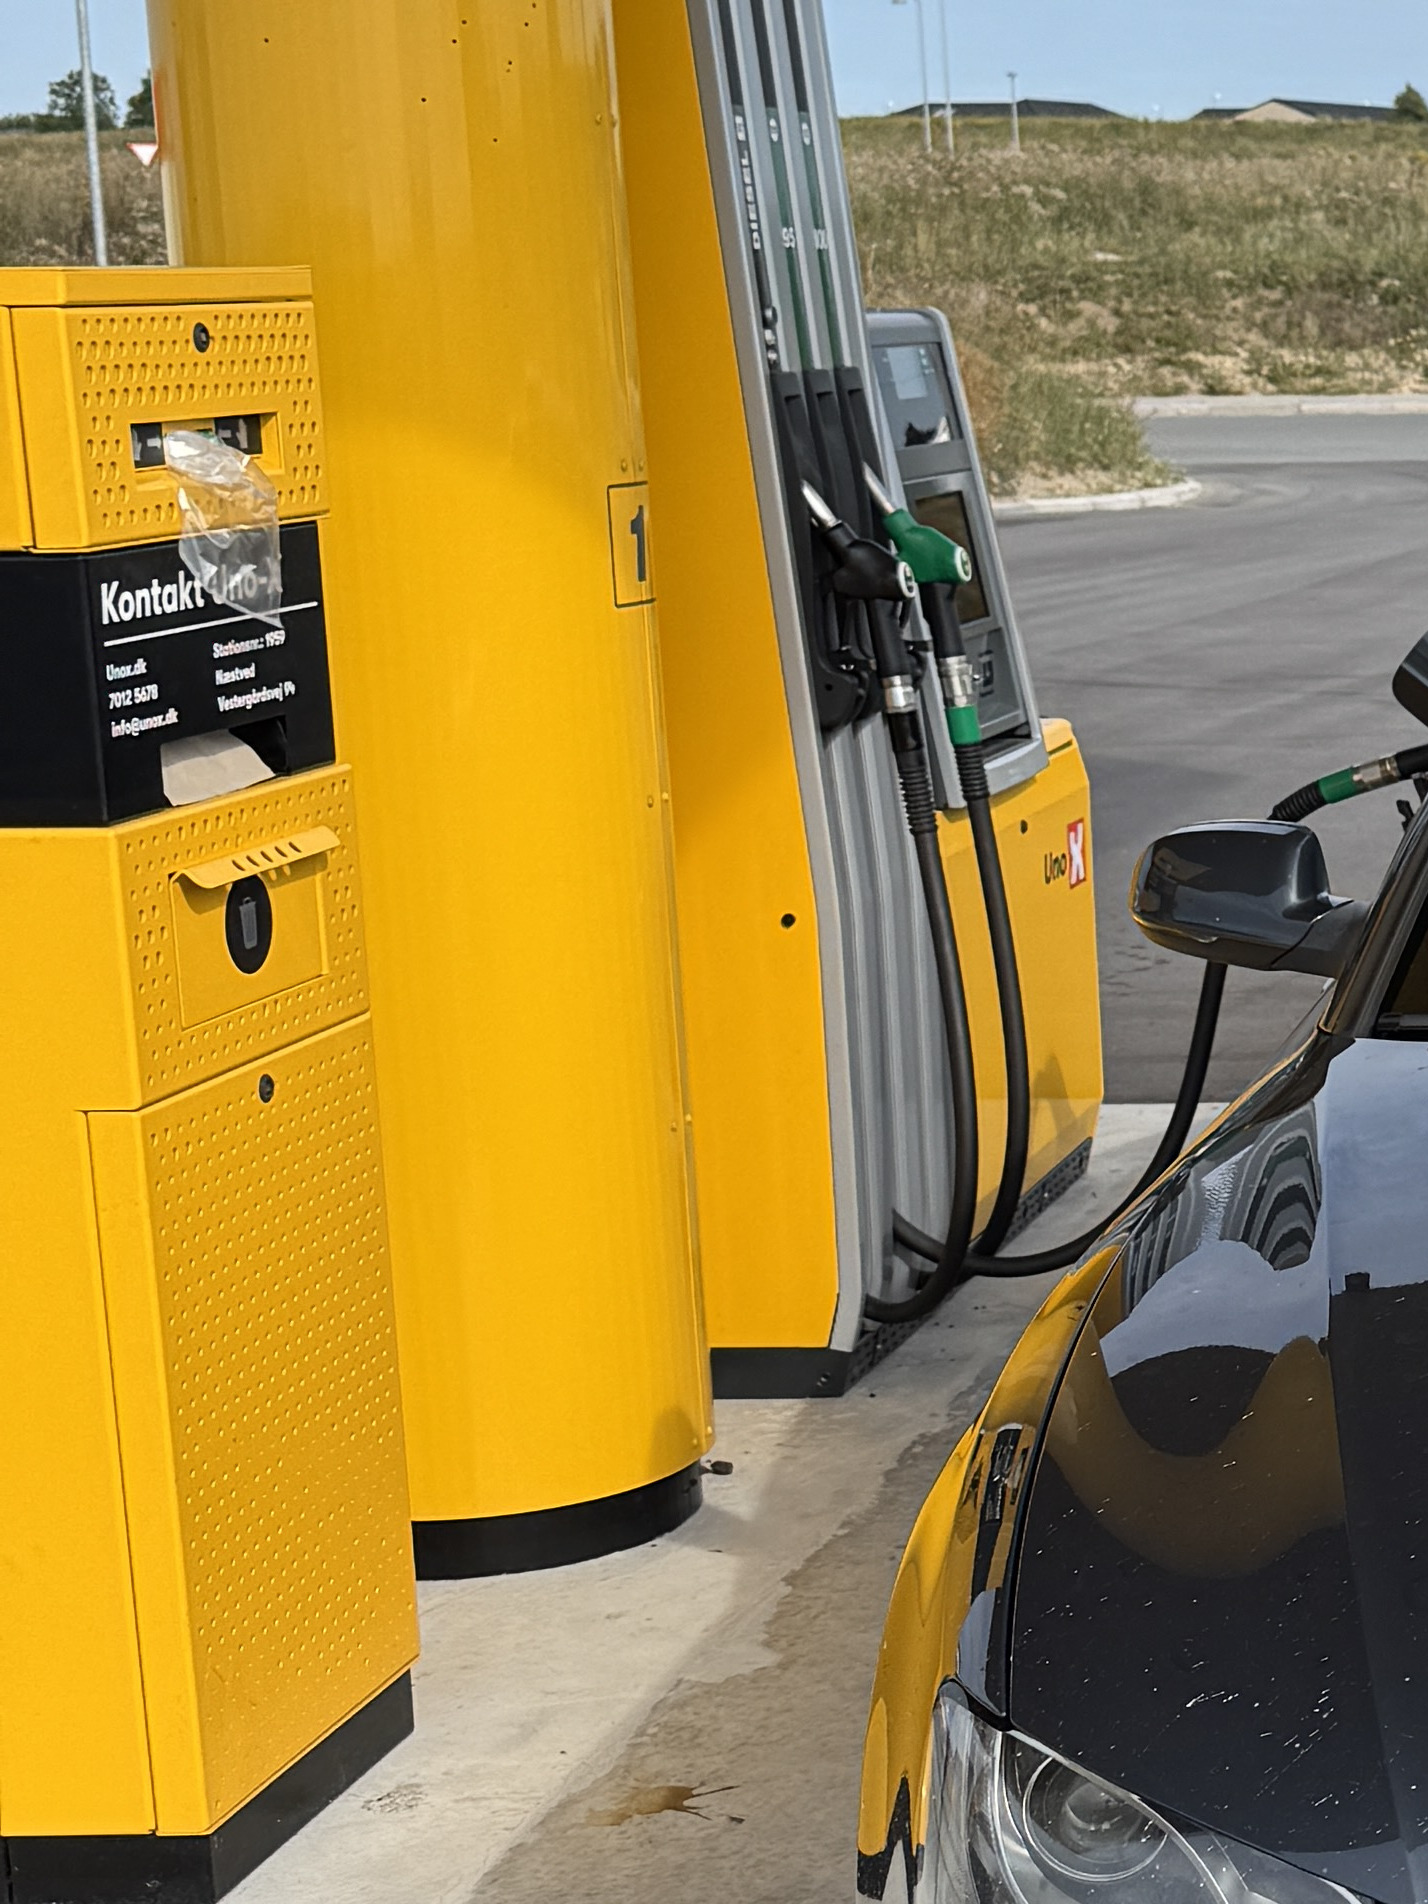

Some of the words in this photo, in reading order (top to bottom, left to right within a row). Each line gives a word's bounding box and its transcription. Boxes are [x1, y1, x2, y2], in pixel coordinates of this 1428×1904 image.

[741, 149, 761, 250] DIESEL
[781, 226, 797, 249] 95
[630, 504, 647, 582] 1
[100, 570, 205, 625] Kontakt
[211, 556, 284, 605] Uno-X
[105, 658, 148, 681] Unox.dk
[108, 689, 133, 710] 7012
[133, 683, 159, 704] 5678
[111, 707, 179, 738] info@unox.dk
[1044, 851, 1067, 885] Uno
[1069, 822, 1085, 886] X
